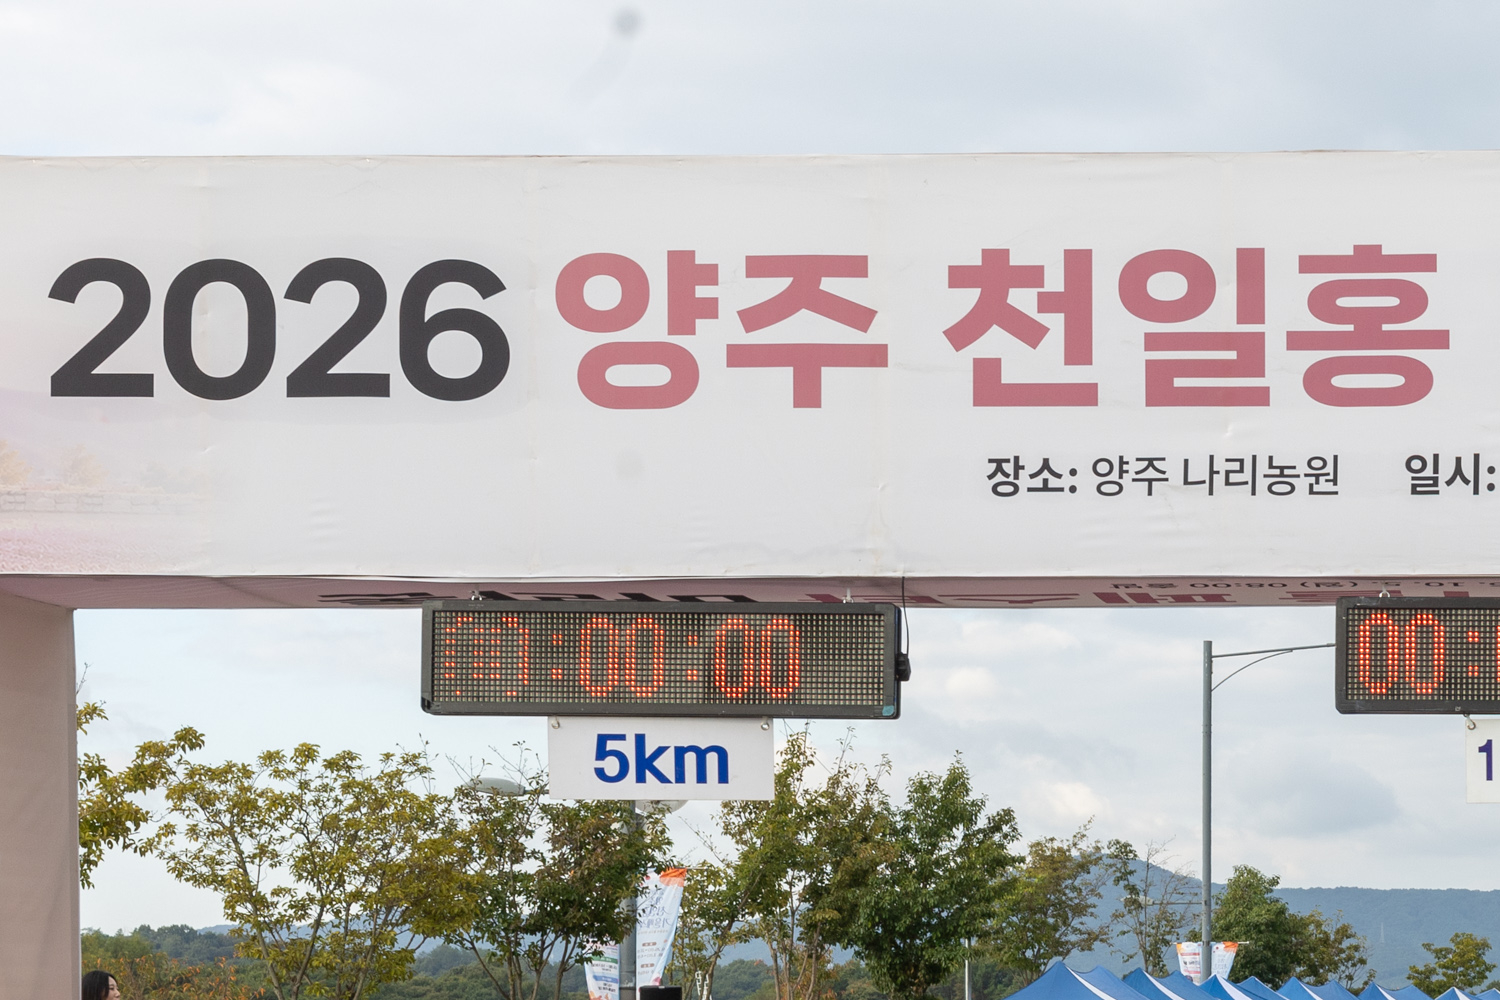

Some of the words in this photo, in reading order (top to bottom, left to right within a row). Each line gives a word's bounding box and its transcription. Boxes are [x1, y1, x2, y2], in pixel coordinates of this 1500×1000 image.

[48, 256, 511, 402] 2026
[555, 249, 889, 410] 양주
[942, 244, 1450, 408] 천일홍
[986, 455, 1078, 498] 장소:
[1091, 455, 1170, 498] 양주
[1181, 453, 1341, 498] 나리농원
[1405, 452, 1497, 496] 일시:
[594, 733, 729, 784] 5km
